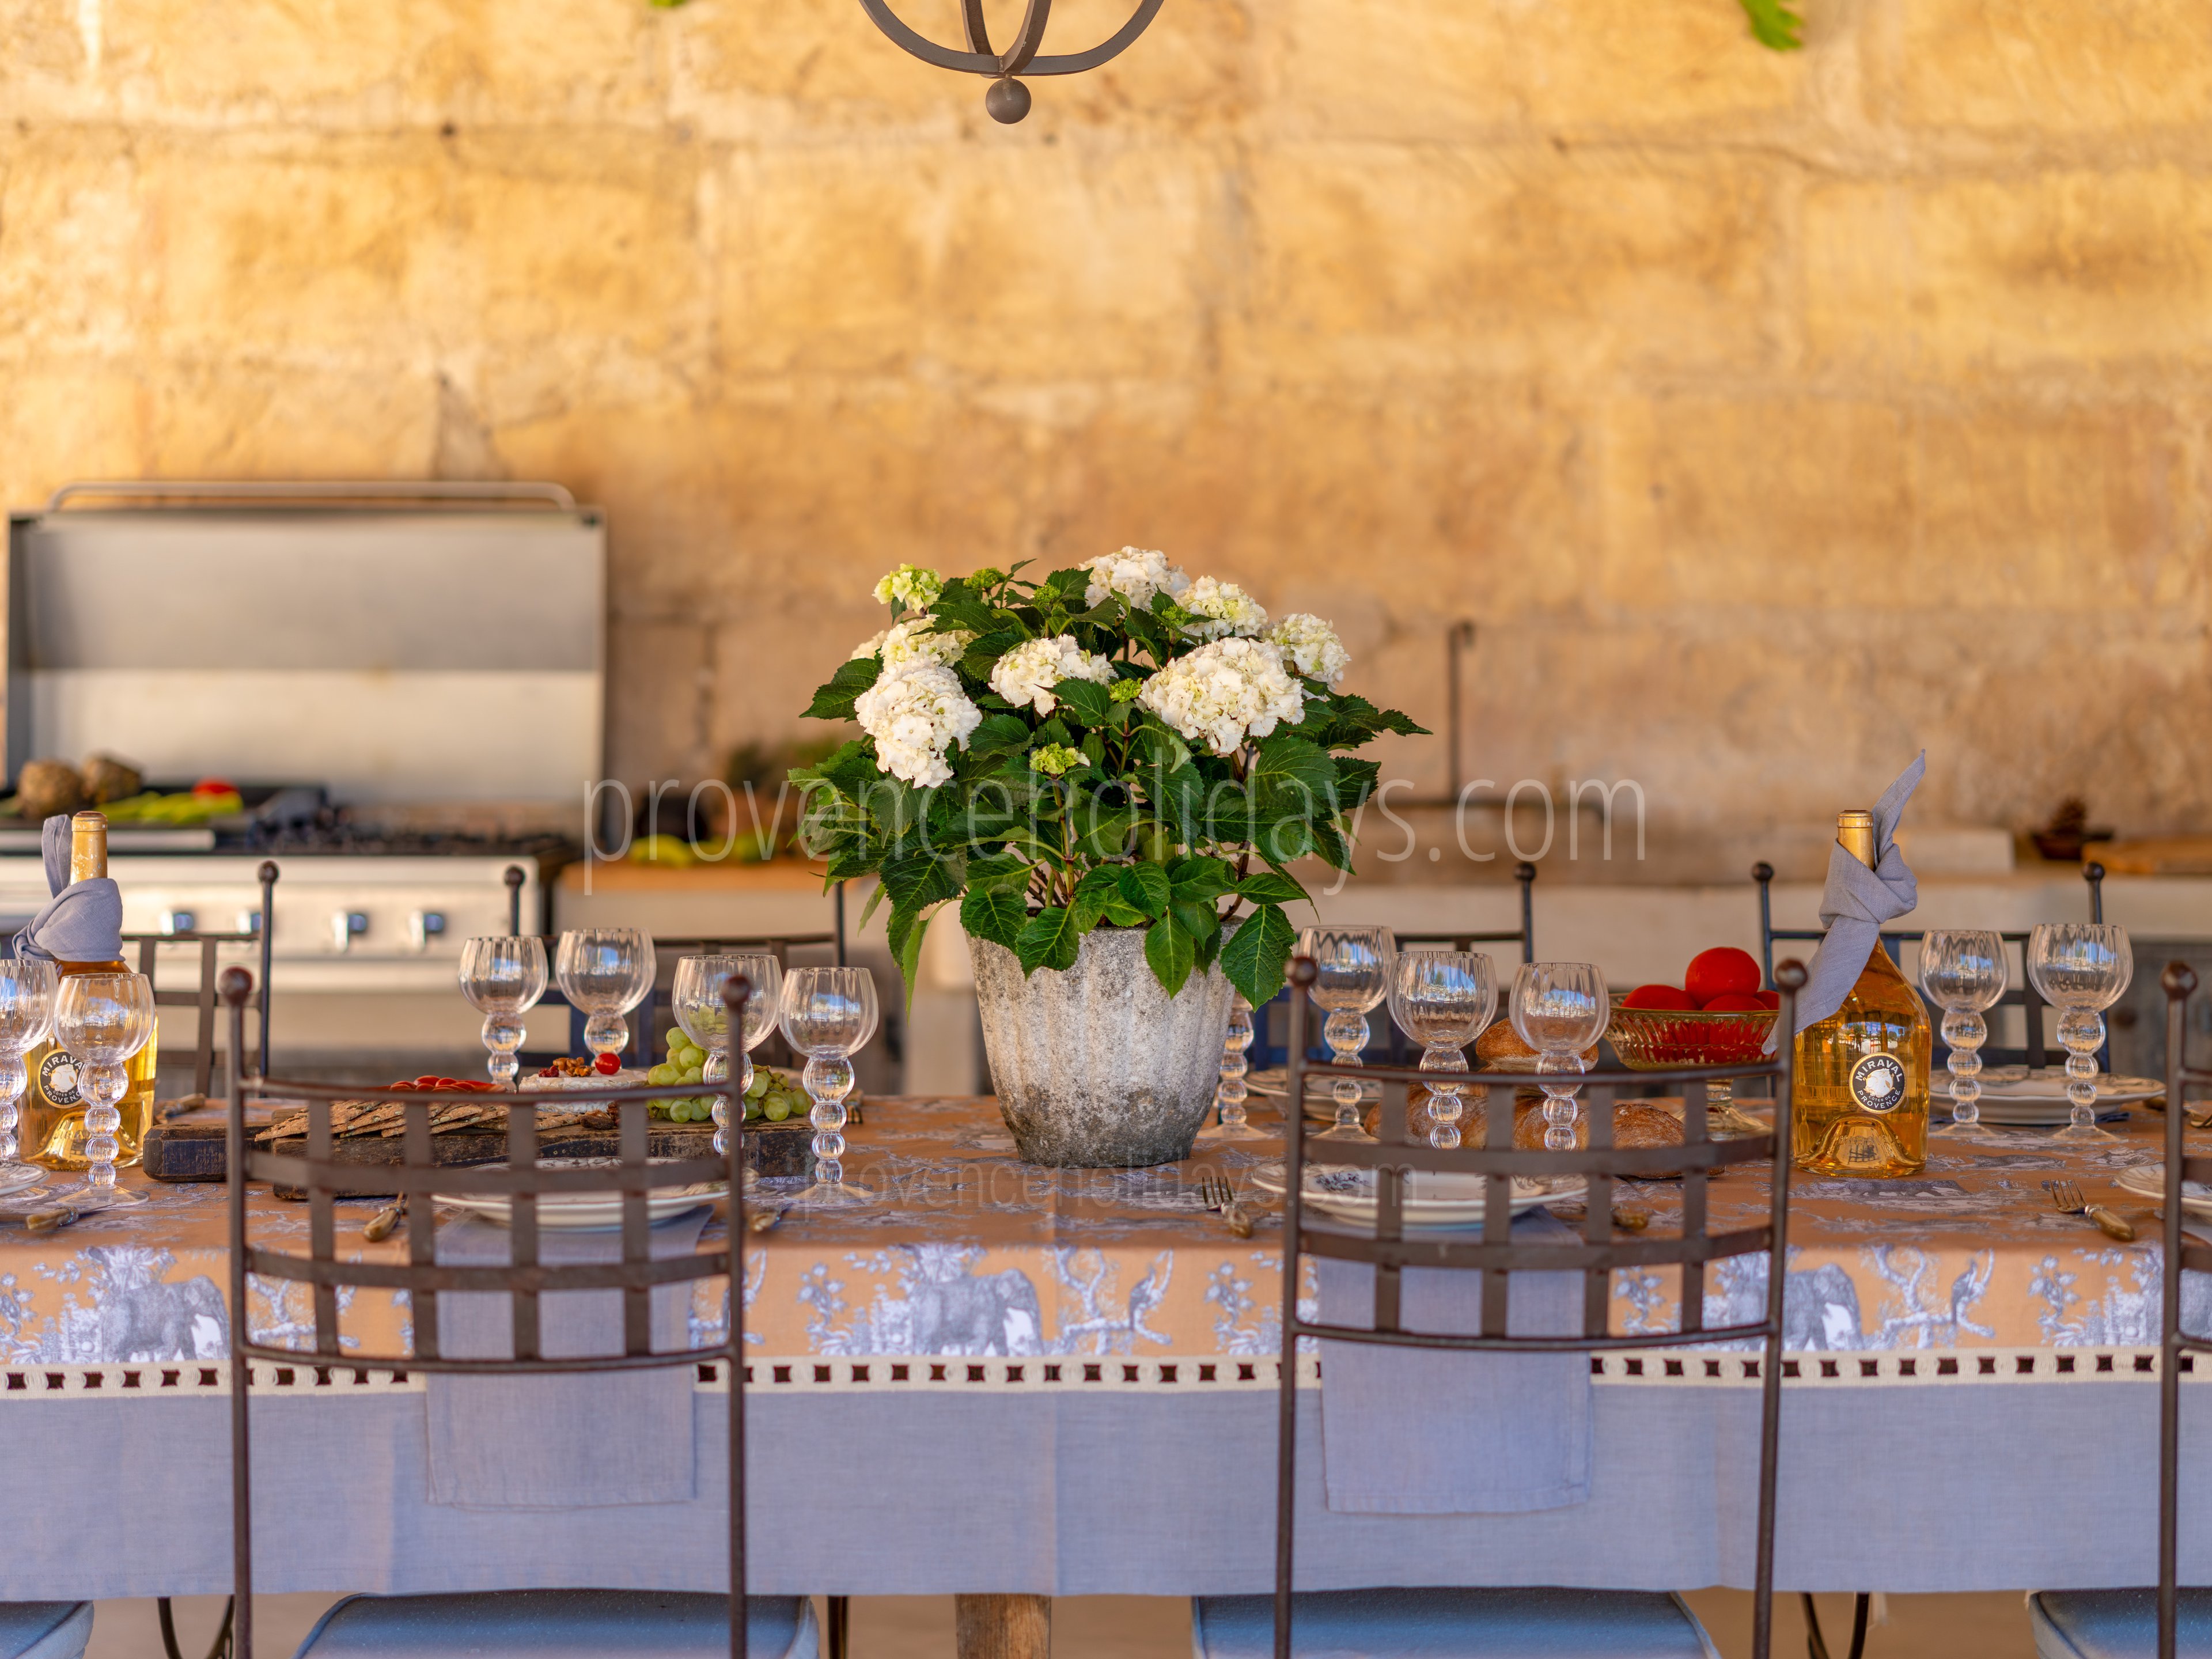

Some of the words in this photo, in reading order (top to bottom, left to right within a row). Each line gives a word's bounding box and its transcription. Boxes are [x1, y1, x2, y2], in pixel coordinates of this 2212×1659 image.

[42, 1055, 84, 1077] MIRAVA
[1855, 1059, 1903, 1082] MIRAVAL
[44, 1086, 81, 1103] PROVENC
[1857, 1090, 1900, 1108] PROVENCE
